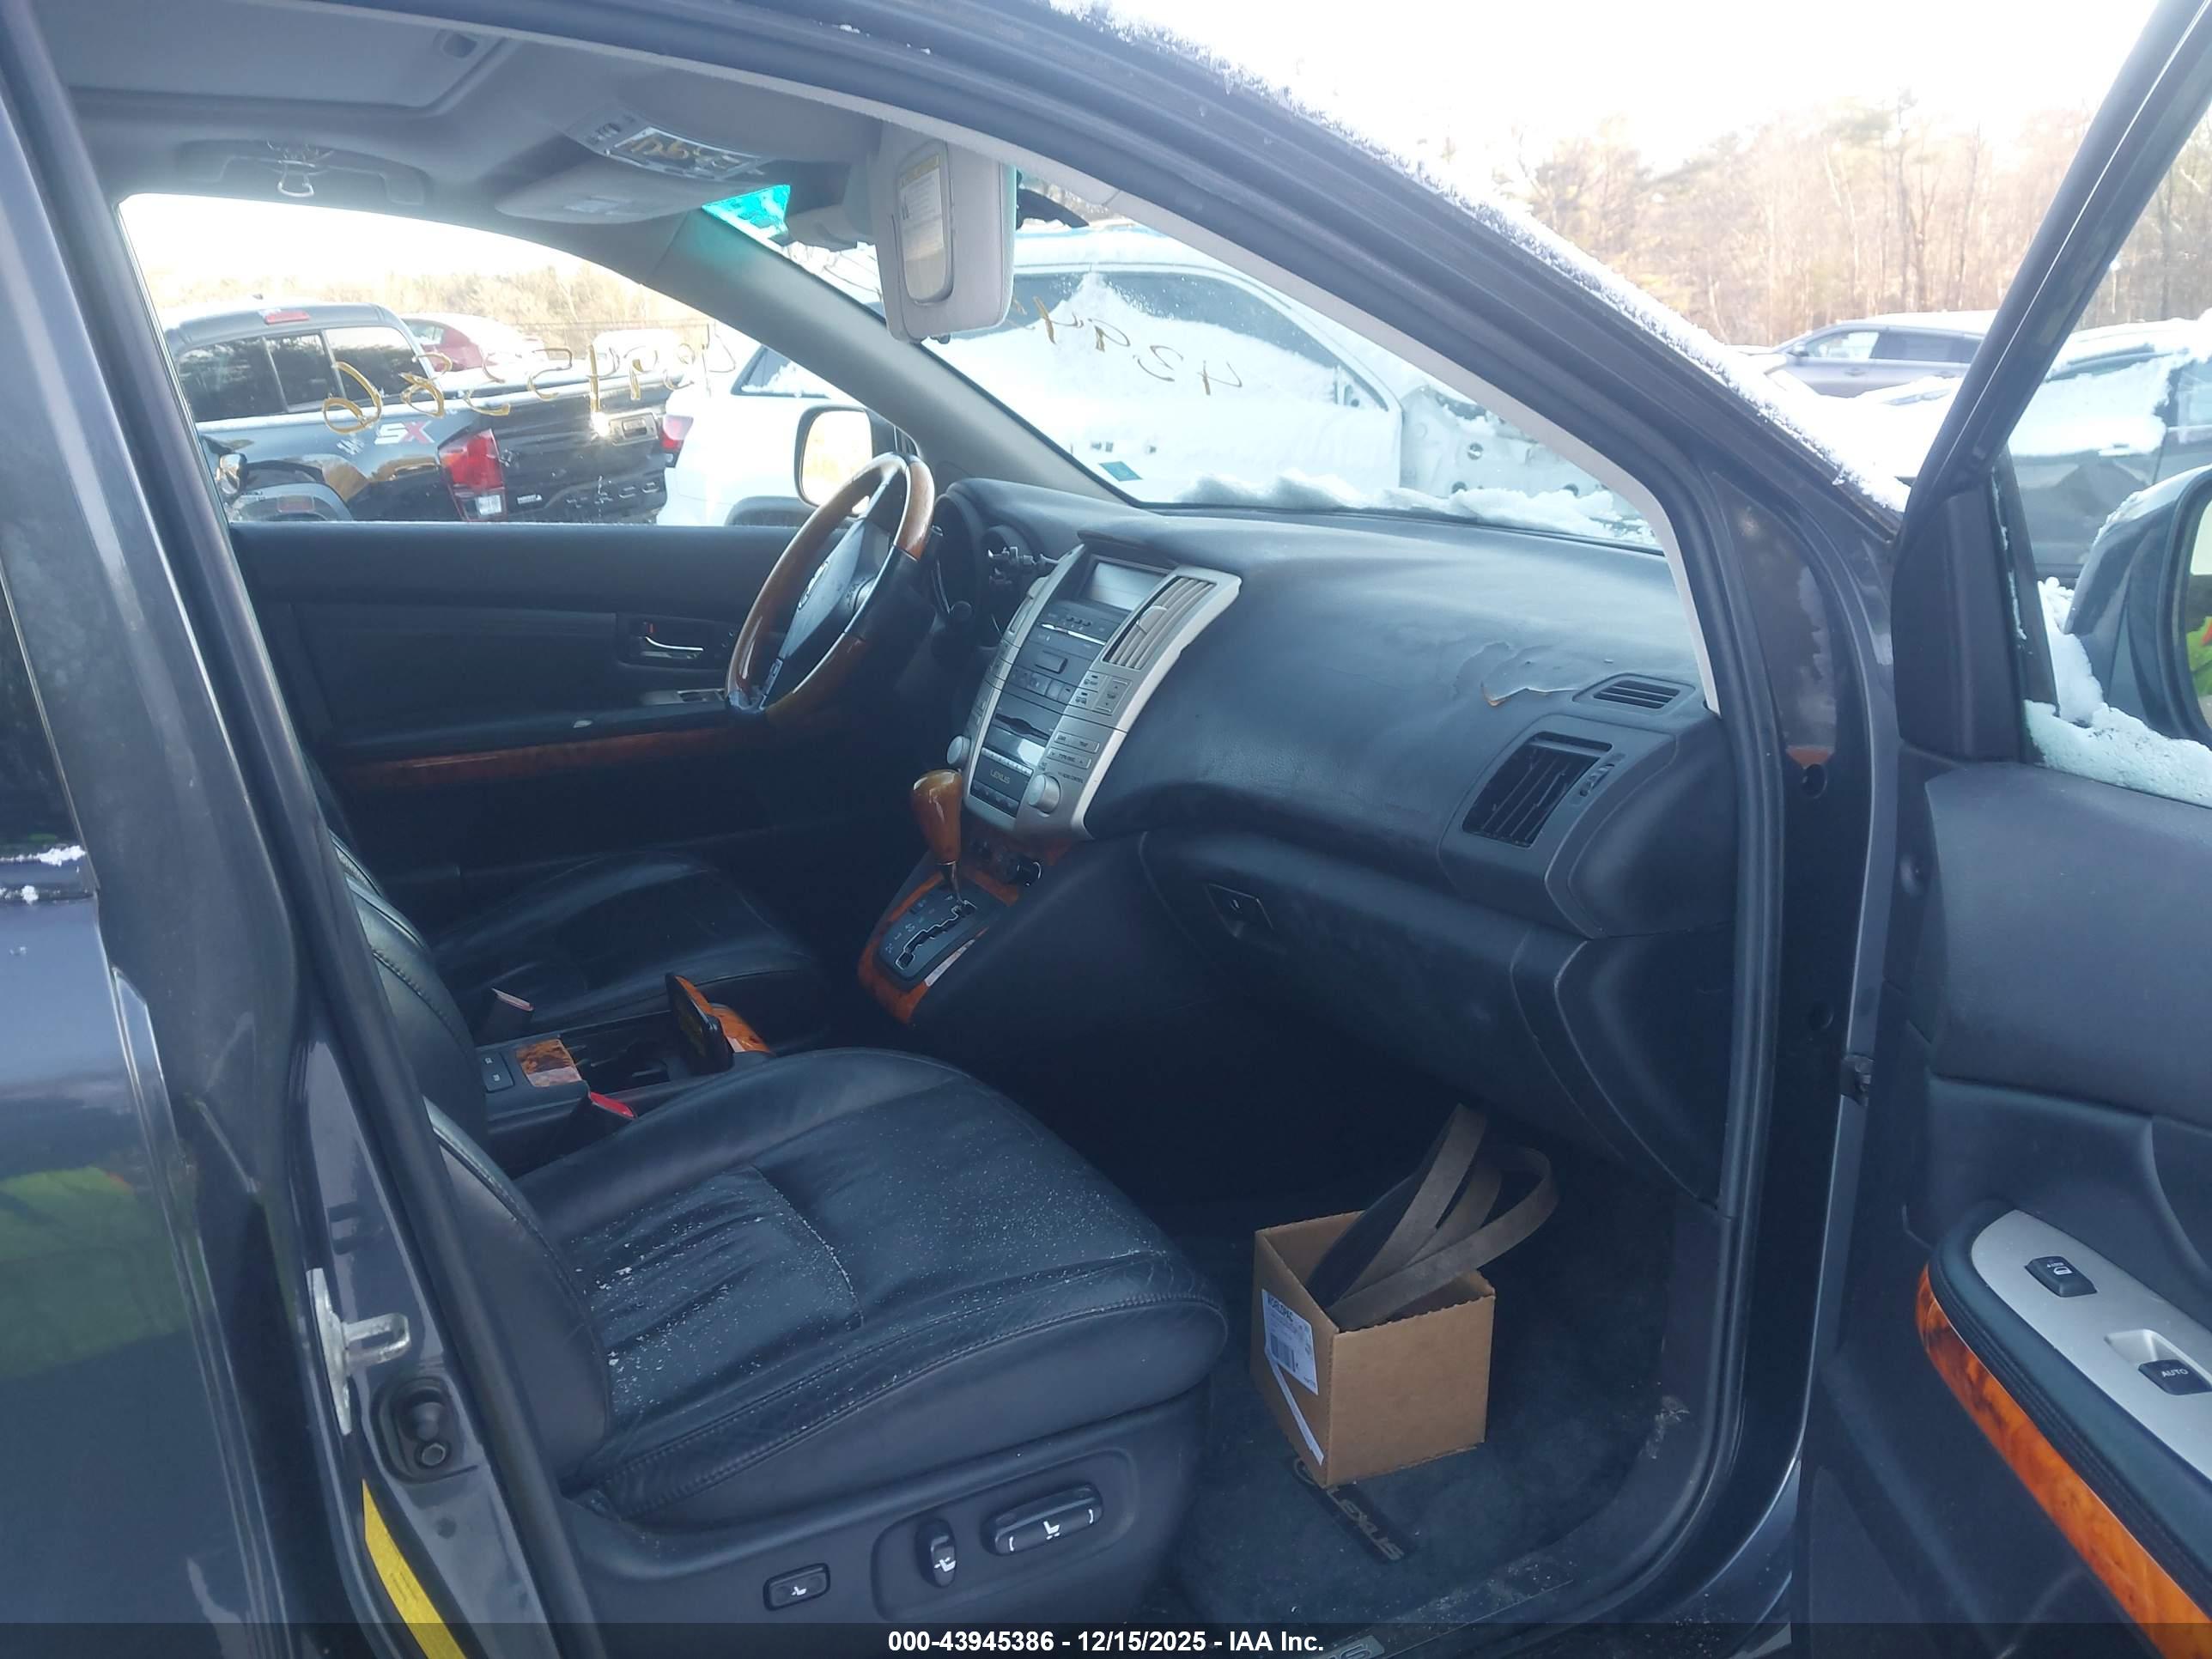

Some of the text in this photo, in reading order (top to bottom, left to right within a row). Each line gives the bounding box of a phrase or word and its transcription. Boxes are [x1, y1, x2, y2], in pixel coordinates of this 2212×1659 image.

[990, 769, 1011, 784] LEXUS
[2160, 1368, 2189, 1377] AUTO
[1327, 1486, 1404, 1560] LEXUS
